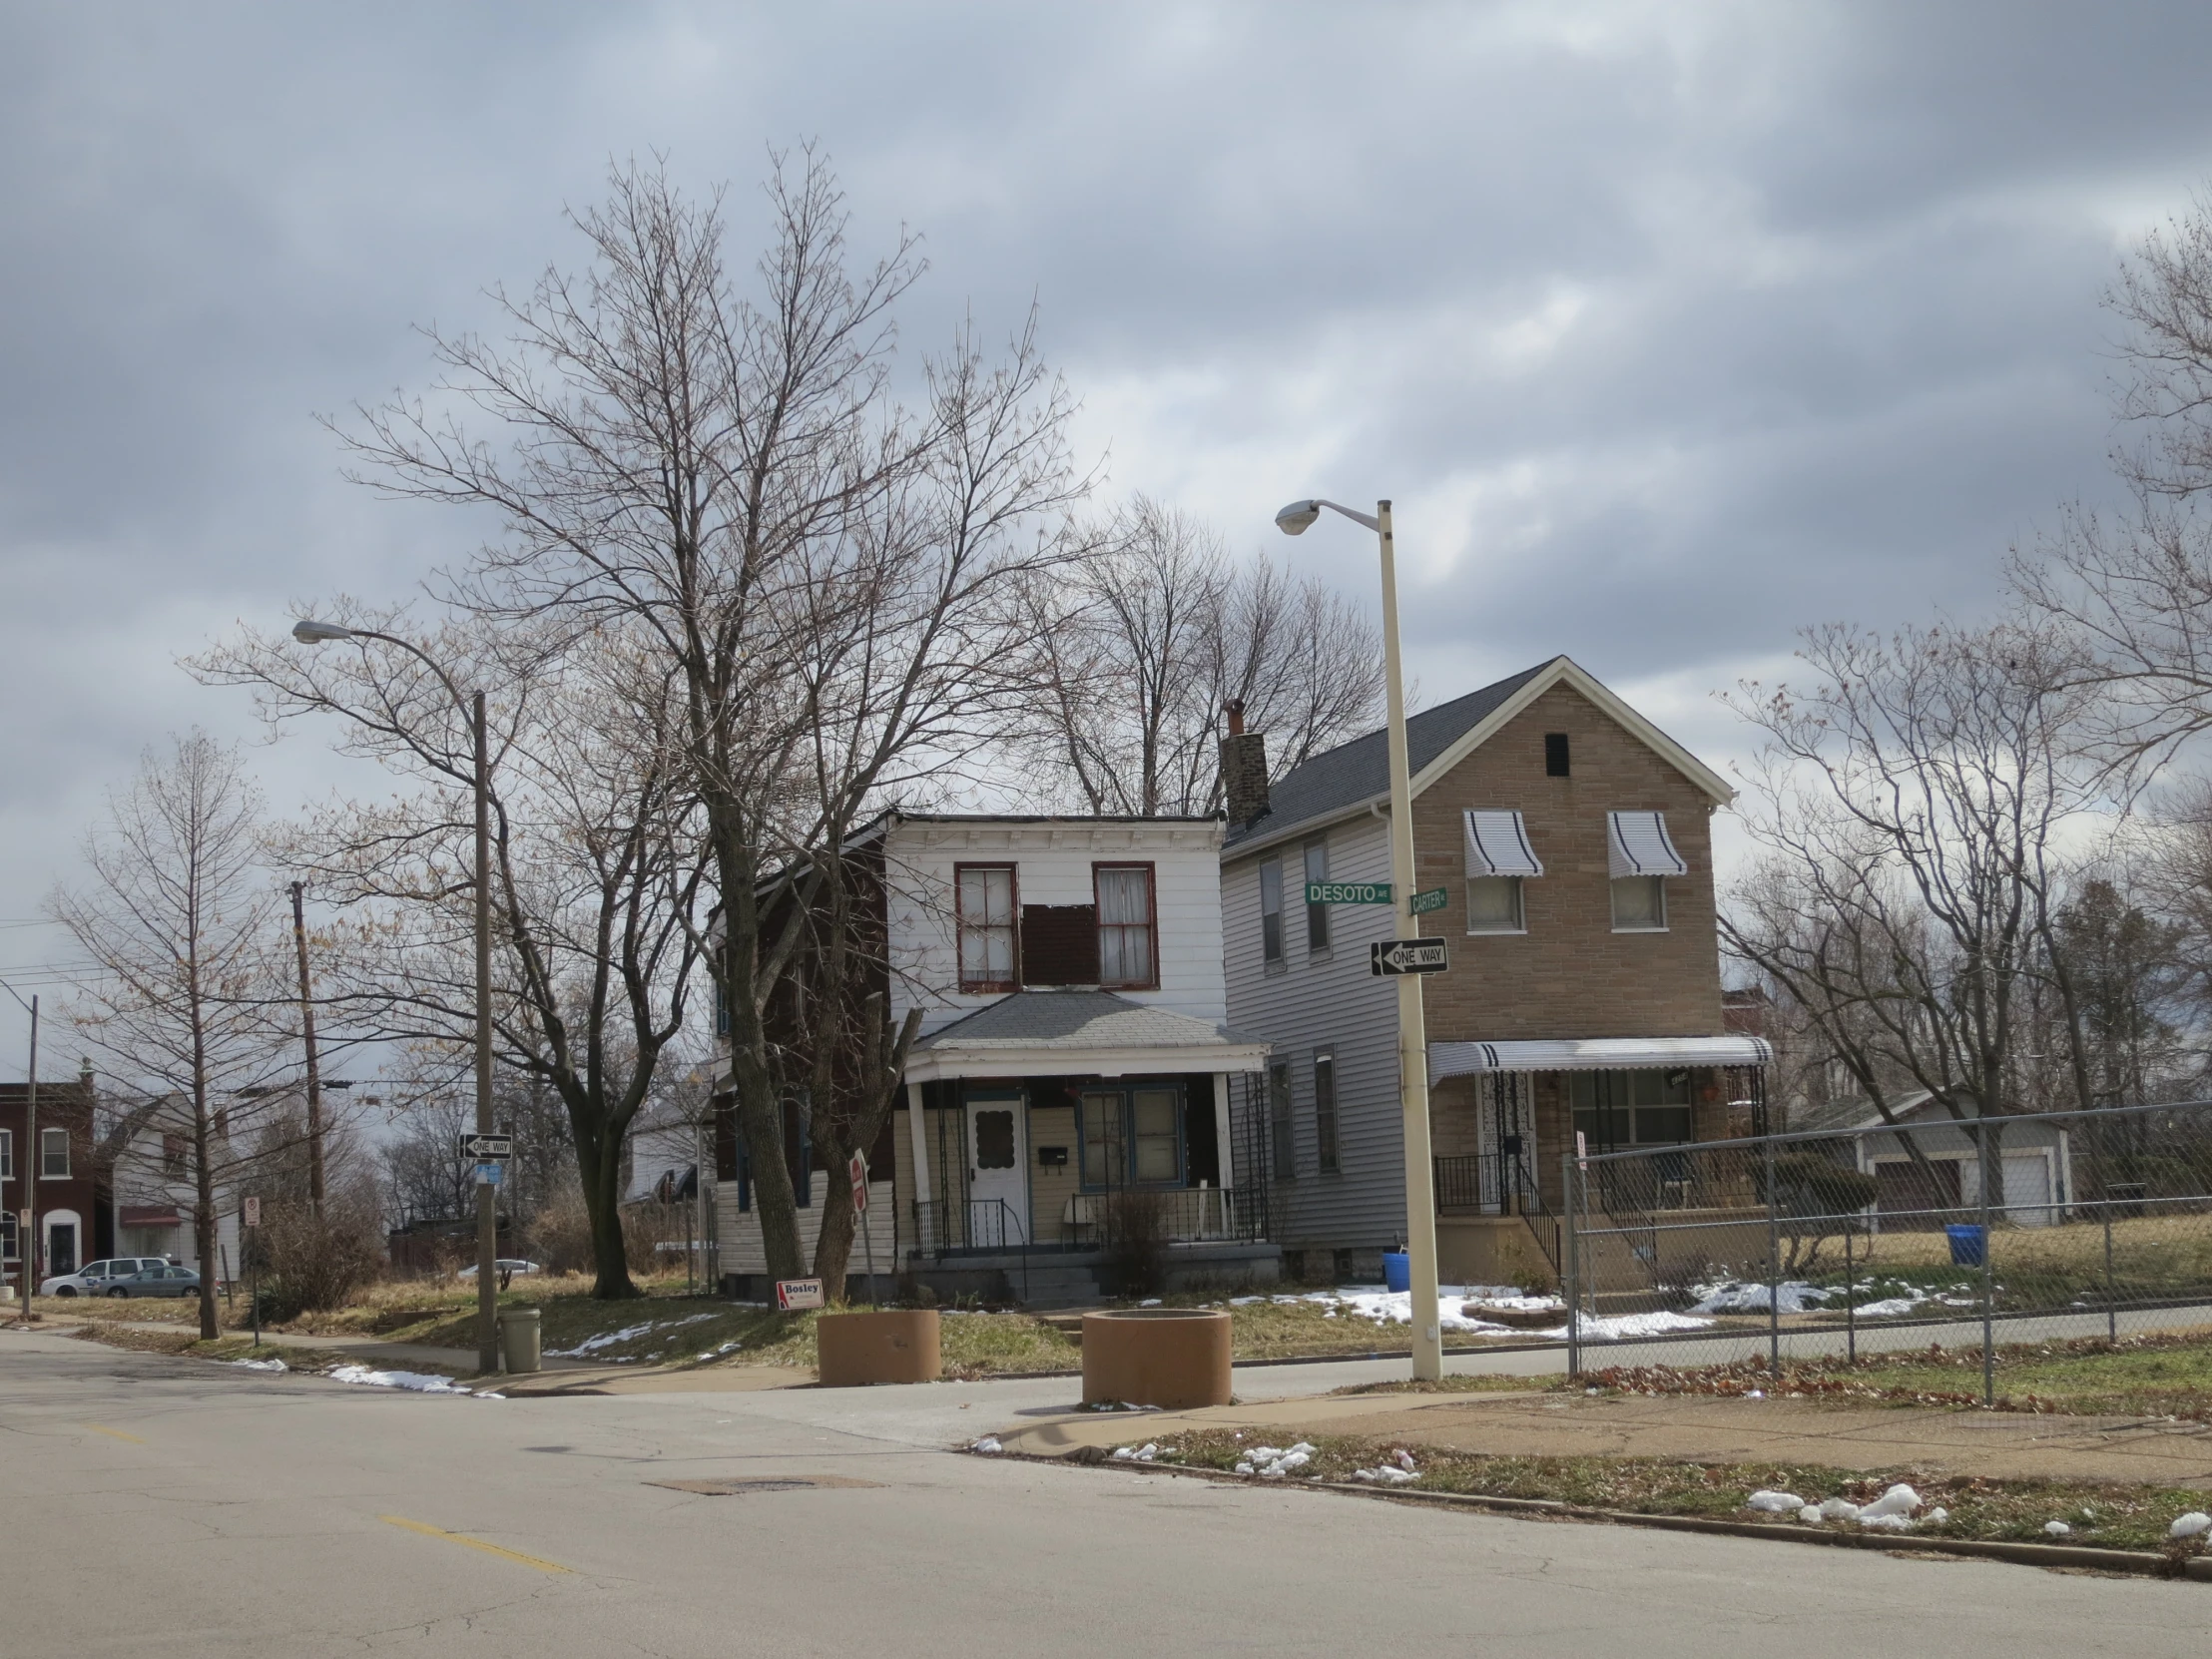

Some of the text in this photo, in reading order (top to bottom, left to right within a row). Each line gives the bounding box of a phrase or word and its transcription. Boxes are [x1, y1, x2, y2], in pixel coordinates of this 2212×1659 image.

[1311, 885, 1376, 901] DESOTO
[1412, 891, 1440, 912] CARTER
[1392, 947, 1441, 964] ONE WAY
[473, 1141, 508, 1152] ONE WAY
[786, 1284, 819, 1294] Bosley
